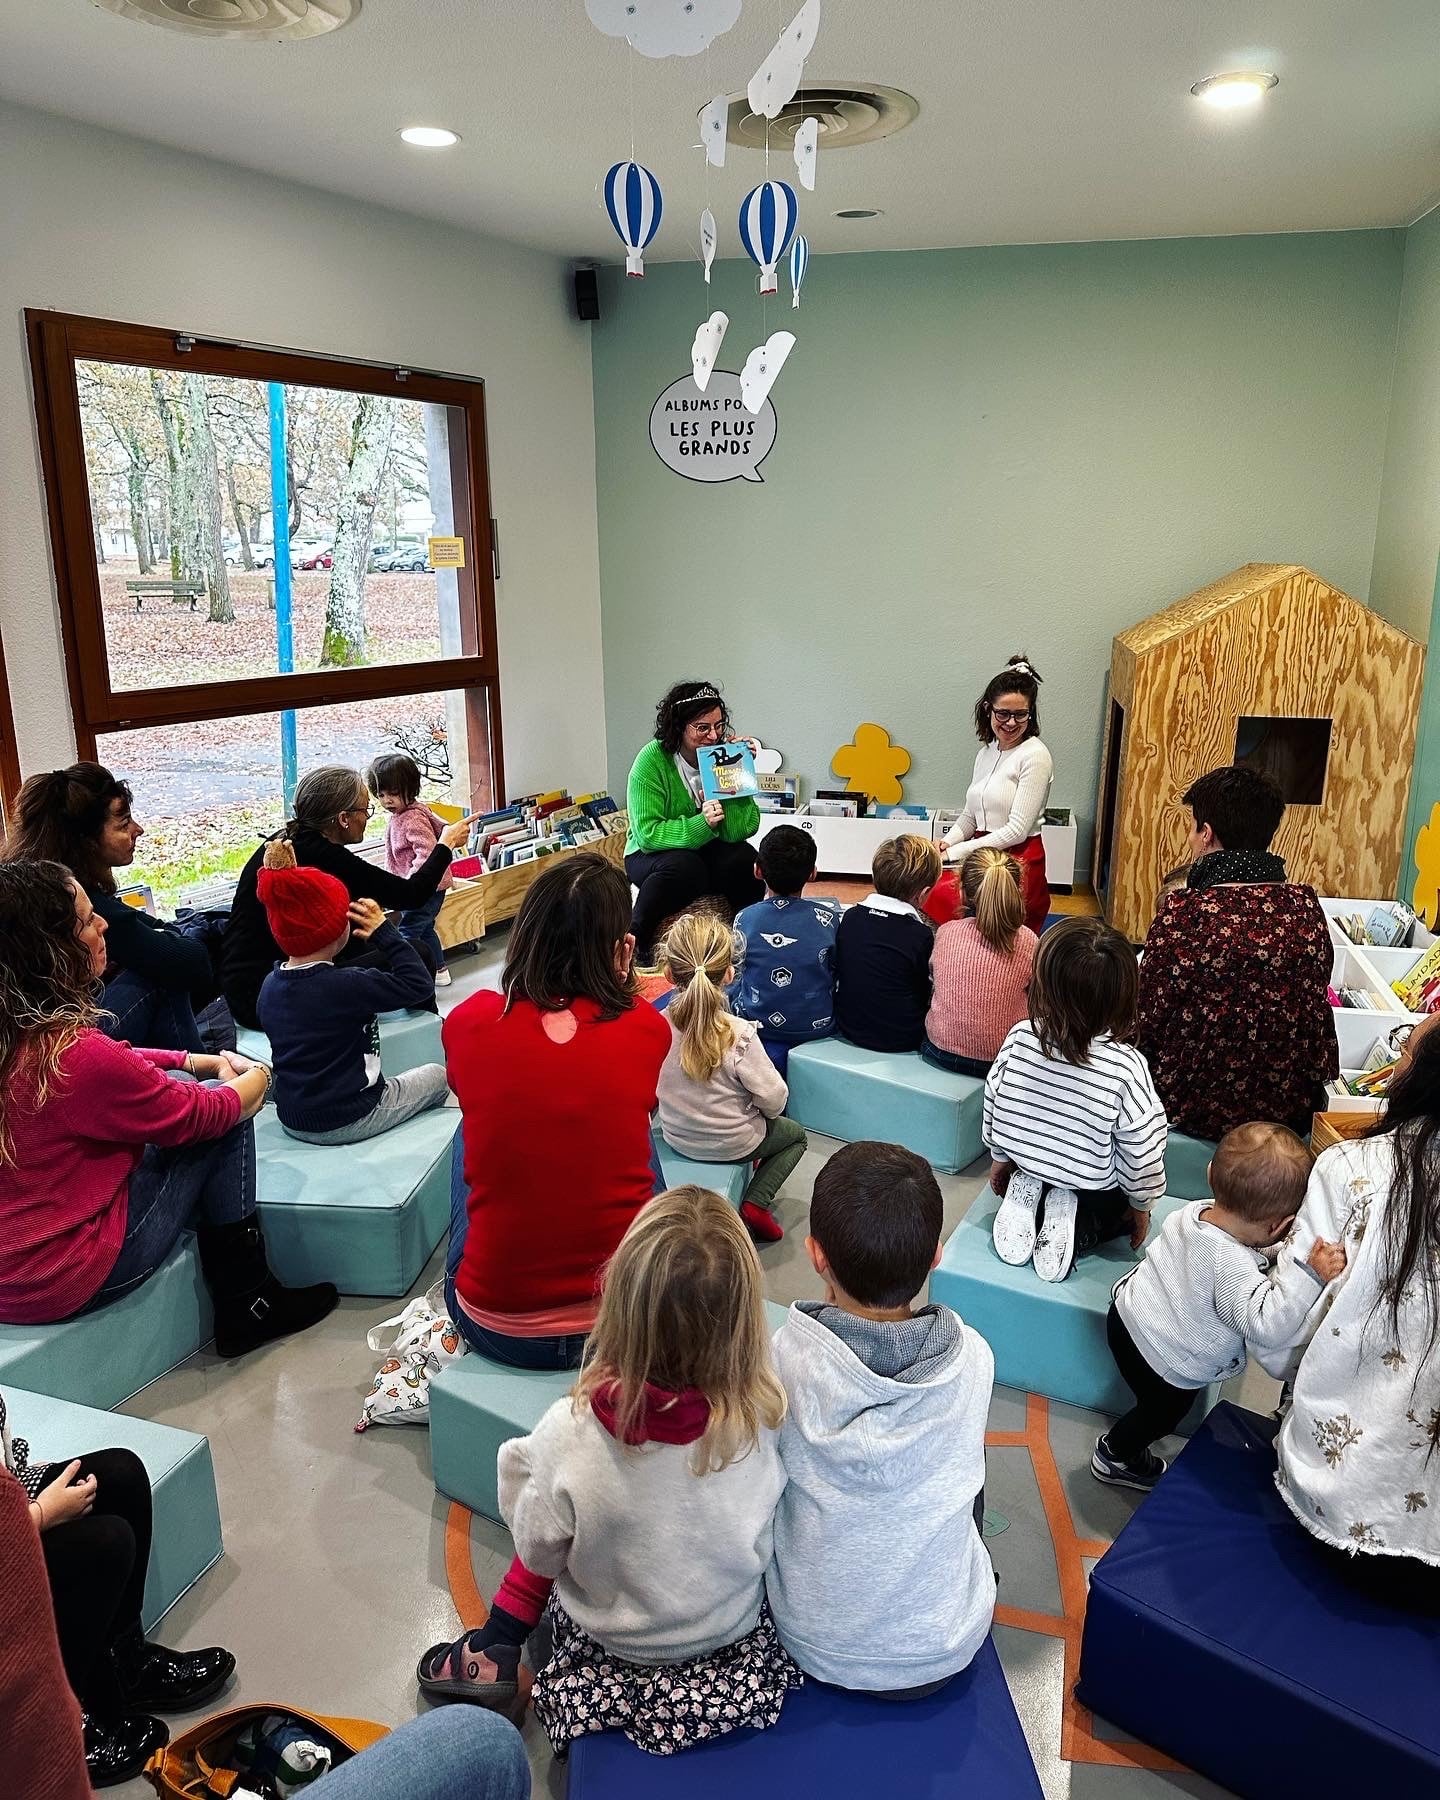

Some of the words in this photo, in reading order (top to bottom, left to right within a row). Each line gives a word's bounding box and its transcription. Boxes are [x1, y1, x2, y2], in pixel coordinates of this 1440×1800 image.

[665, 399, 720, 412] ALBUMS
[724, 398, 748, 412] PO
[670, 421, 700, 437] LES
[711, 420, 756, 437] PLUS
[679, 439, 752, 456] GRANDS
